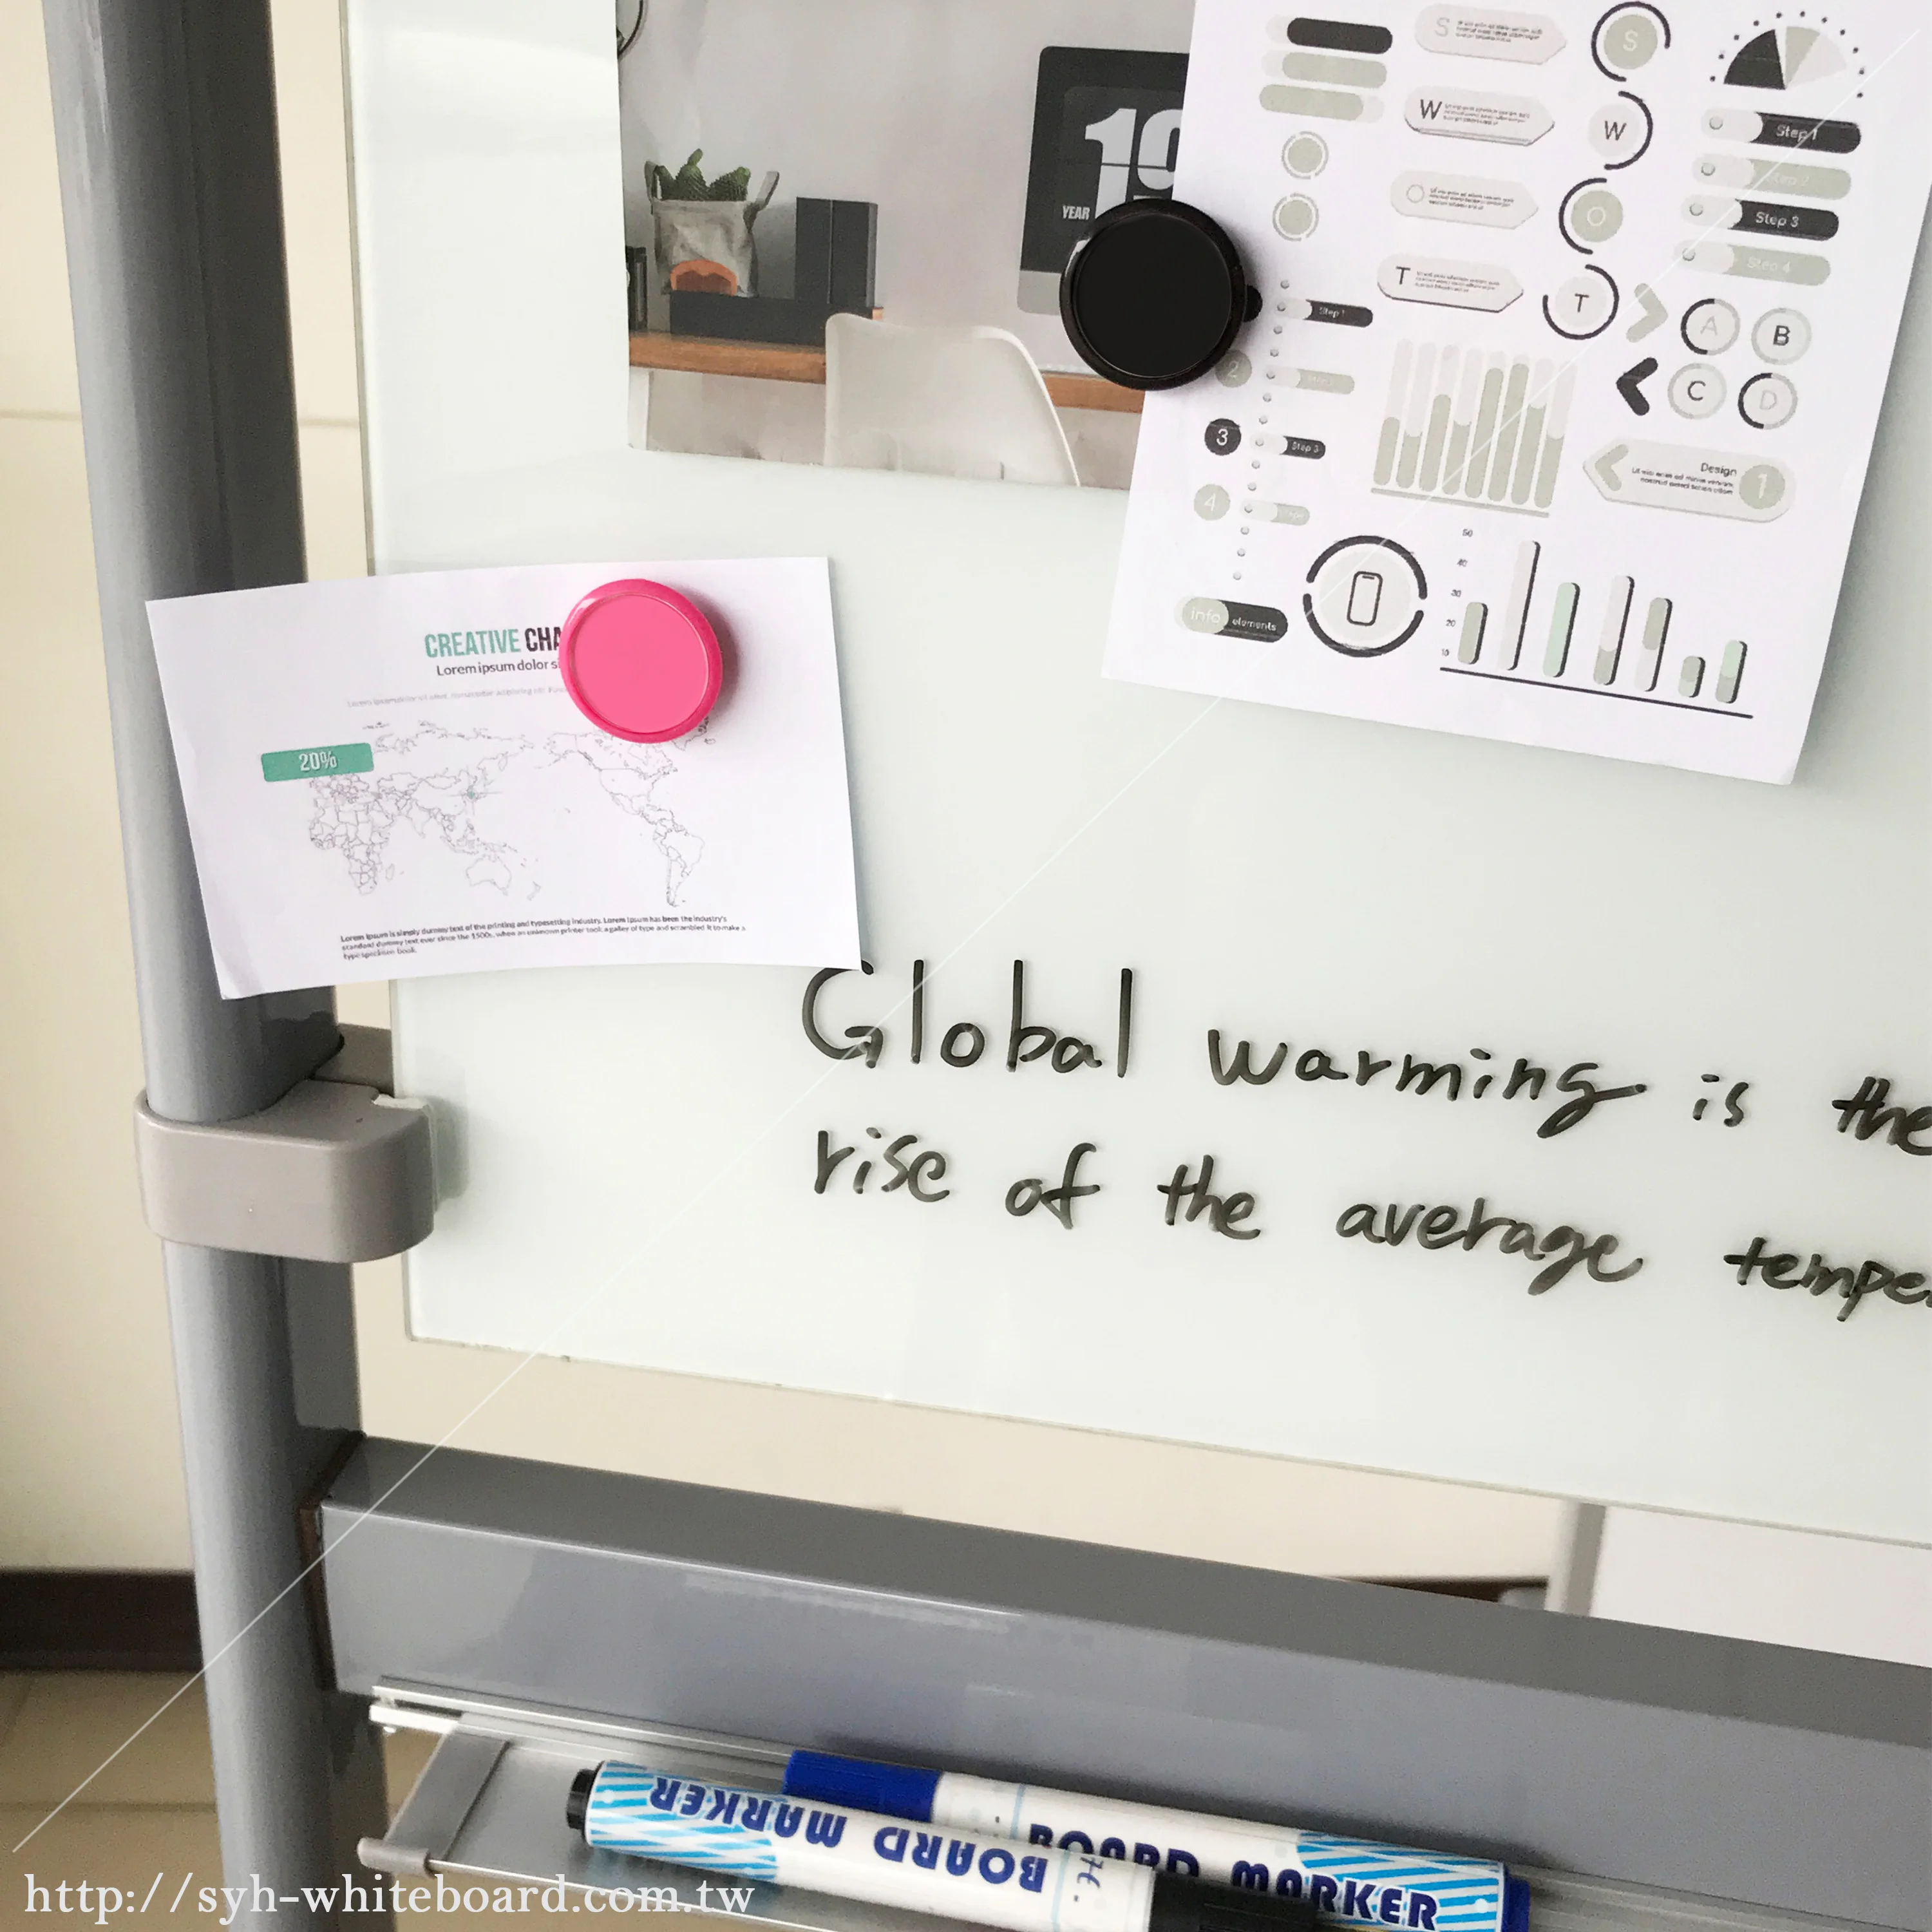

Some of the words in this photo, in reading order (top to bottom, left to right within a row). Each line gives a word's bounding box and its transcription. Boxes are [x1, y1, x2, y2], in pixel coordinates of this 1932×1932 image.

[1434, 17, 1450, 37] S
[1622, 30, 1638, 52] S
[1420, 99, 1443, 120] W
[1604, 120, 1627, 142] W
[1776, 124, 1807, 141] Step
[1811, 128, 1819, 140] 1
[1063, 205, 1090, 220] YEAR
[1756, 212, 1787, 228] Step
[1790, 216, 1799, 227] 3
[1396, 266, 1411, 285] T
[1575, 292, 1589, 313] T
[1700, 316, 1718, 335] A
[1772, 325, 1790, 346] B
[1228, 361, 1239, 378] 2
[1687, 381, 1707, 401] C
[1760, 390, 1776, 410] D
[1217, 429, 1228, 446] 3
[1292, 441, 1311, 453] Step
[1313, 444, 1319, 453] 3
[1700, 462, 1737, 477] Design
[1757, 473, 1767, 499] 1
[1204, 493, 1216, 511] 4
[1463, 529, 1473, 537] 50
[1191, 607, 1221, 624] info
[1232, 617, 1277, 632] elements
[1446, 619, 1456, 627] 20
[424, 629, 522, 658] CREATIVE
[524, 627, 561, 652] CHA
[1441, 649, 1449, 657] 10
[437, 663, 477, 677] Lorem
[478, 661, 515, 676] ipsum
[517, 659, 548, 672] dolor
[299, 750, 337, 772] 20%
[802, 958, 1133, 1078] Global
[1208, 1029, 1647, 1139] warming
[1693, 1074, 1749, 1128] is
[1832, 1076, 1932, 1156] the
[815, 1127, 950, 1202] rise
[1005, 1142, 1101, 1229] of
[1157, 1155, 1261, 1240] the
[1336, 1197, 1643, 1295] average
[1723, 1236, 1932, 1322] tempe
[649, 1776, 848, 1848] MARKER
[873, 1826, 1048, 1893] BOARD
[1231, 1860, 1437, 1931] MARKER
